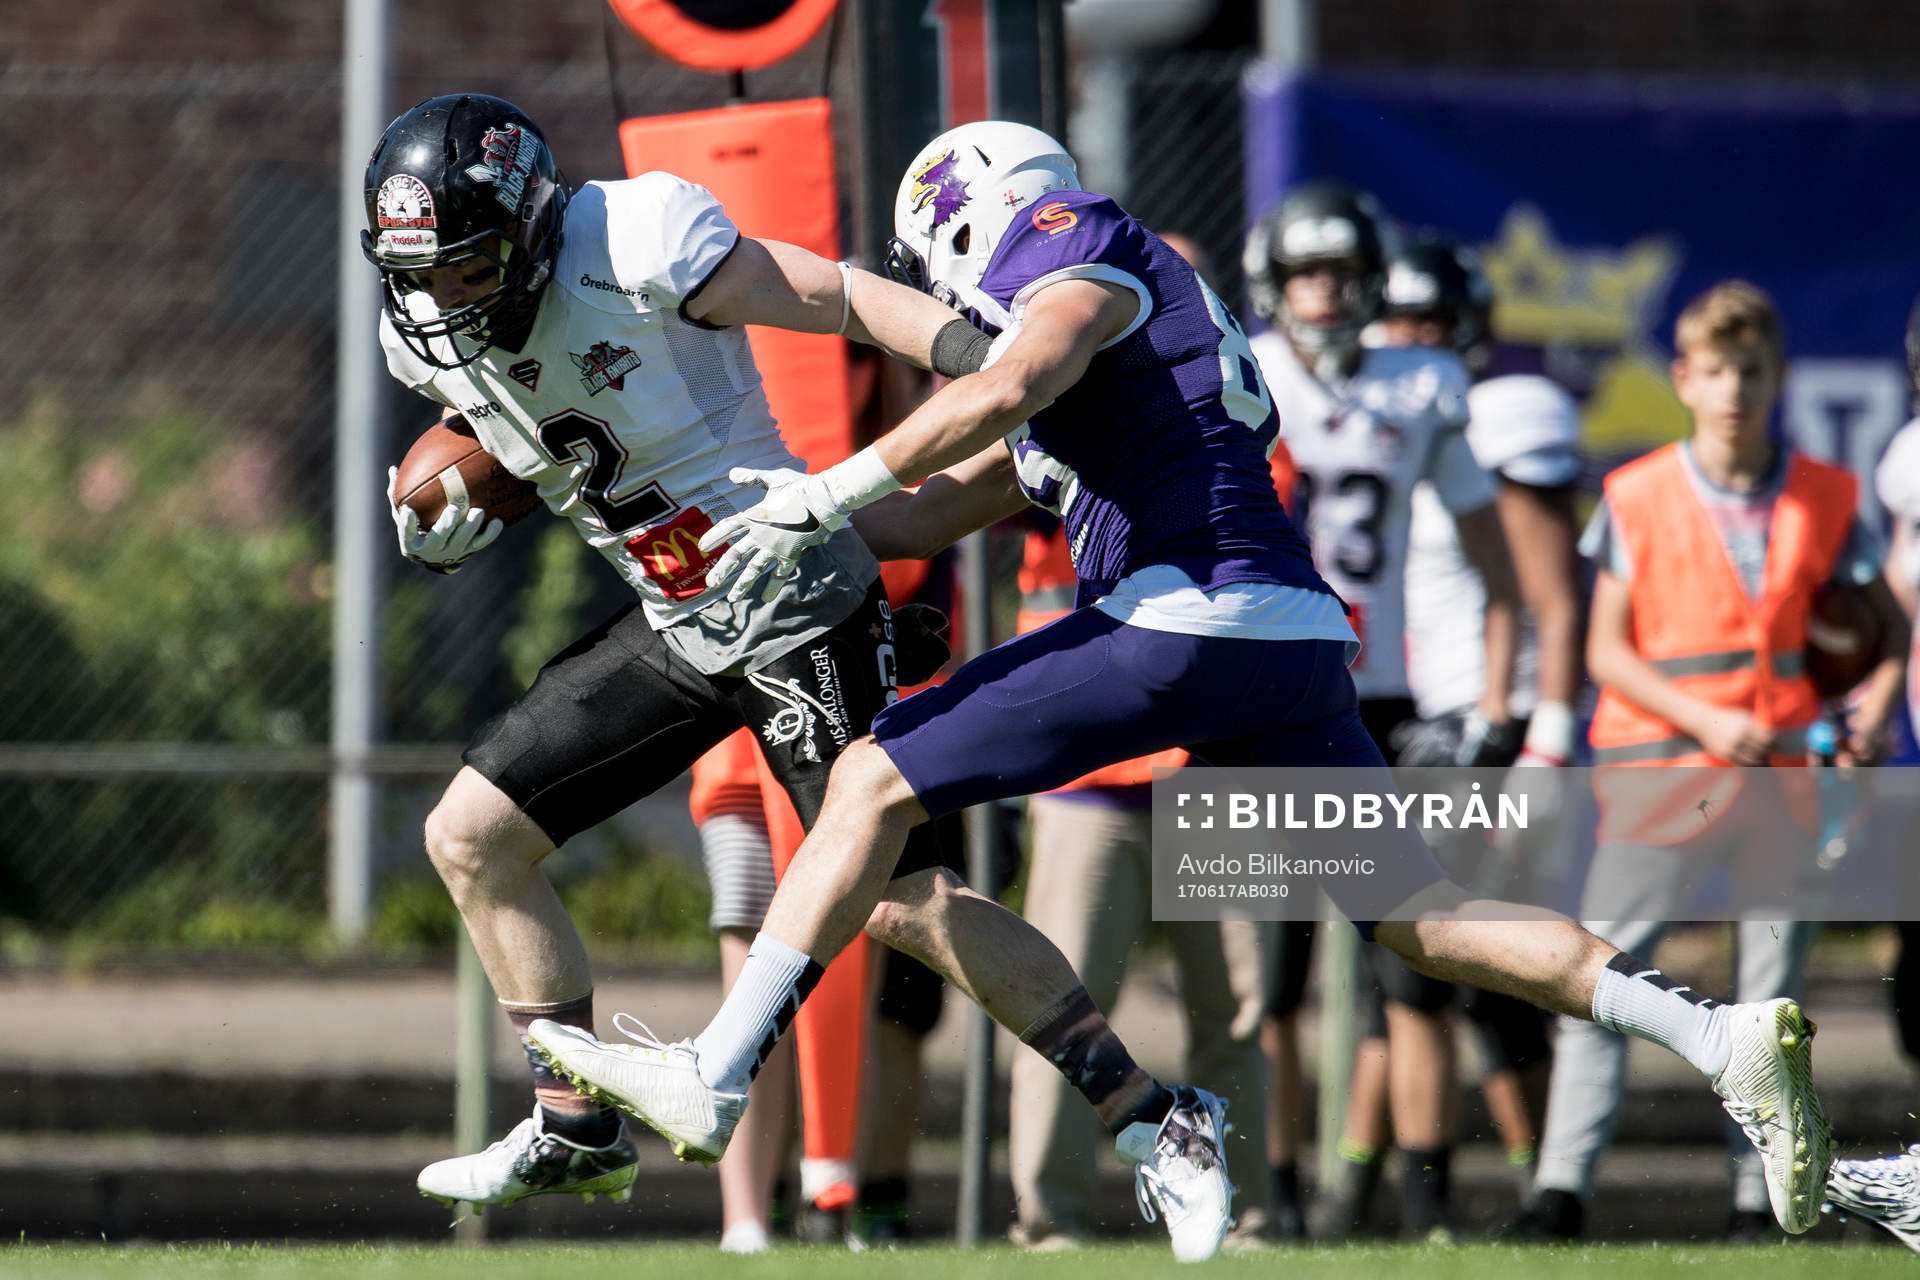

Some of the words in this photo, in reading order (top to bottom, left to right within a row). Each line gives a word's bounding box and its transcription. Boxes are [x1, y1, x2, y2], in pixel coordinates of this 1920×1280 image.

[412, 182, 431, 208] CITY
[498, 167, 525, 212] BLACK
[514, 128, 540, 174] KNIGHTS
[390, 233, 424, 246] Riddell
[536, 408, 682, 536] 2
